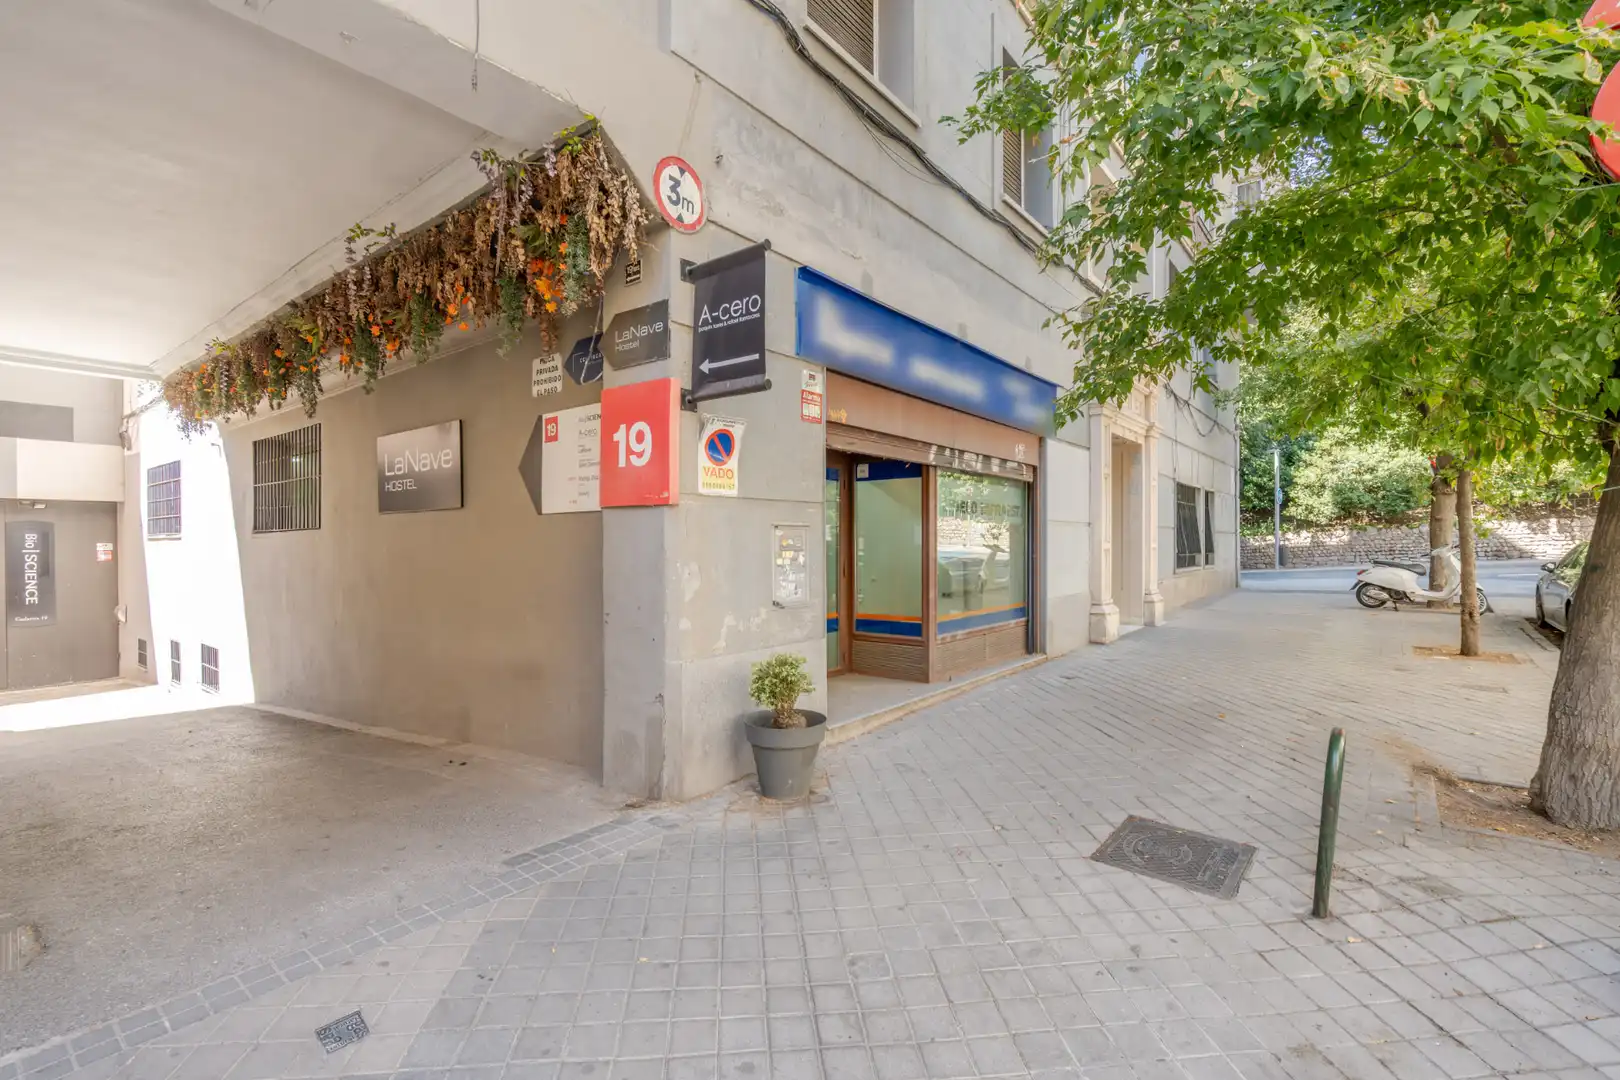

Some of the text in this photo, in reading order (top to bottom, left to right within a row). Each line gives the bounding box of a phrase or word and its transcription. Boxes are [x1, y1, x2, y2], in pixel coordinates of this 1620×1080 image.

[699, 294, 762, 326] A-cero
[615, 321, 664, 343] LaNave
[615, 340, 640, 353] Hostel
[536, 364, 559, 376] PRIVADA
[533, 375, 562, 387] PROHIBIDO
[544, 386, 558, 396] PASO
[546, 422, 557, 437] 19
[612, 421, 653, 468] 19
[384, 446, 453, 476] LaNave
[703, 466, 734, 480] VADO
[384, 478, 418, 492] HOSTEL
[24, 554, 39, 605] SCIENCE
